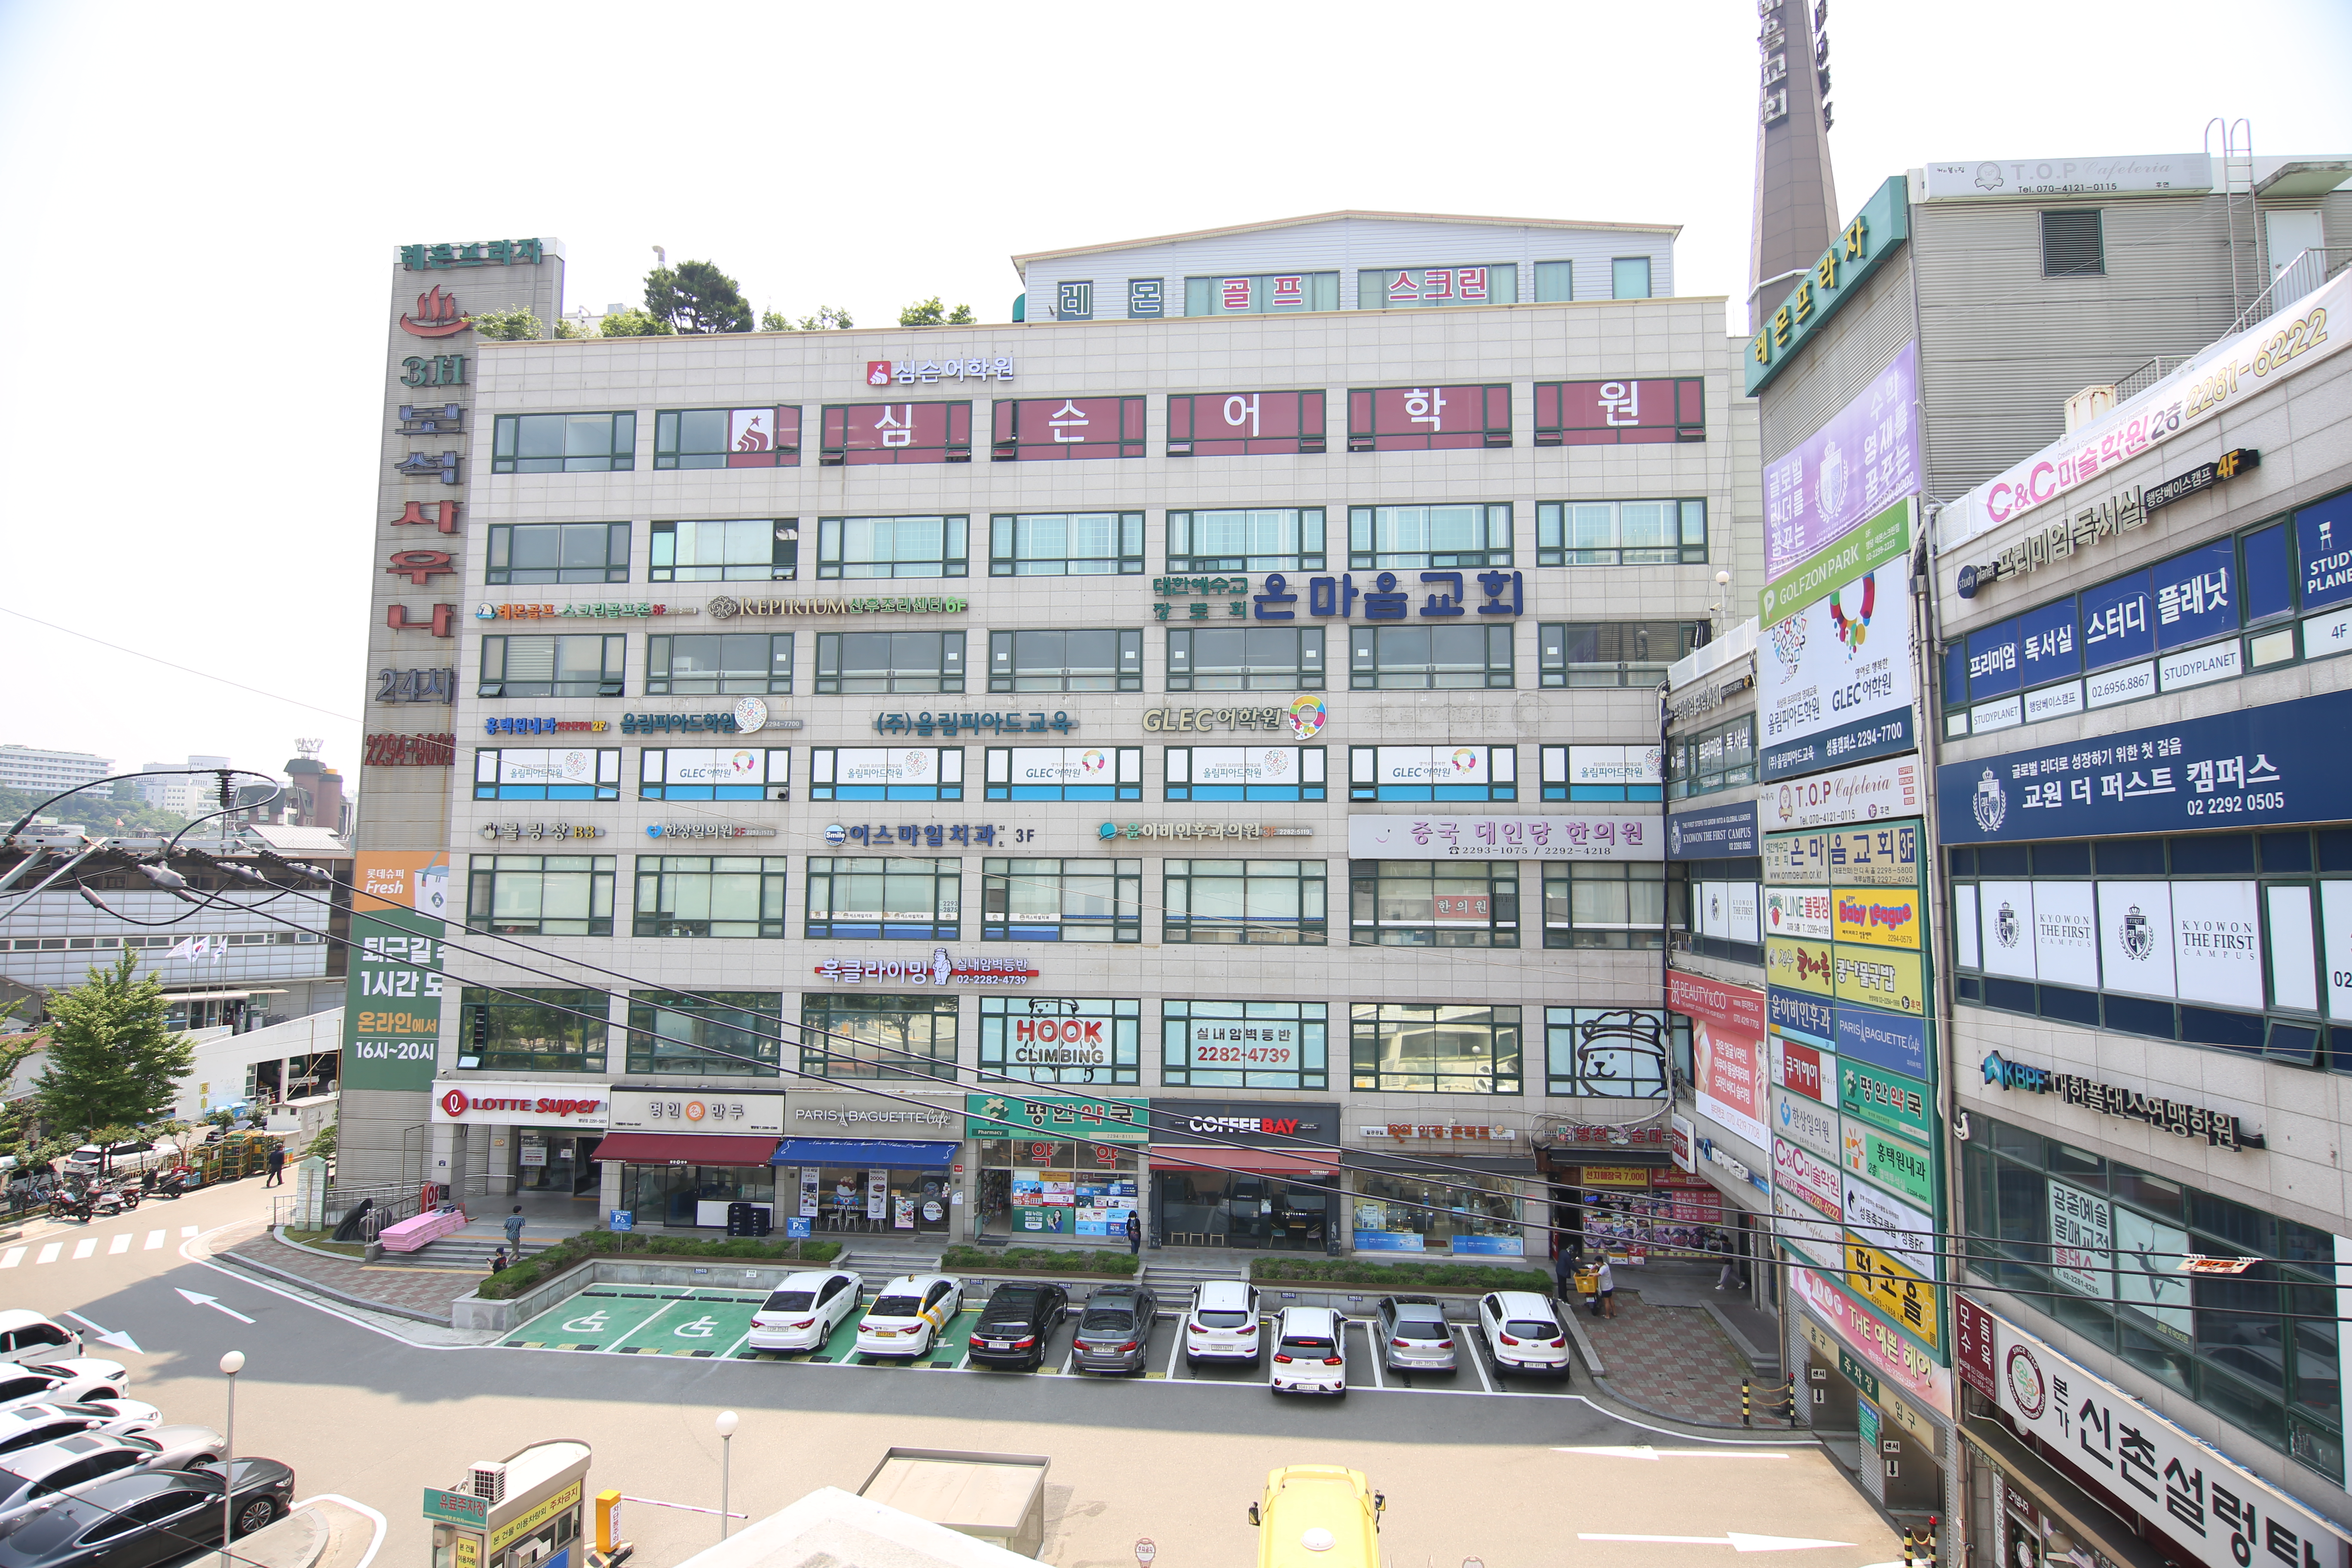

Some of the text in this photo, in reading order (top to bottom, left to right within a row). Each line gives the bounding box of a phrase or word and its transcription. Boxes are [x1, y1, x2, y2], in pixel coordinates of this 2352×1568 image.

[2037, 182, 2117, 192] 070-4121-0115
[401, 238, 543, 270] 레몬프라자
[1754, 215, 1868, 366] 레몬프라자
[895, 357, 1014, 385] 심슨어학원
[1987, 307, 2328, 523] C&C 미술학원 2층 2281-6222
[1864, 400, 1908, 466] 영재를
[1770, 456, 1803, 498] 글로벌
[1958, 451, 2240, 590] study planet 프리미엄 독서실 행당베이스캠프 4F
[1154, 576, 1248, 596] 대한예수교
[1779, 542, 1860, 605] GOLFZON PARK
[739, 596, 967, 616] REPIRIUM 산후조리센터 6F
[1253, 570, 1523, 620] 온마음교회
[497, 603, 556, 619] 레몬골프
[561, 603, 651, 619] 스크린골프존
[1969, 567, 2228, 678] 프리미엄 독서실 스터디 플래닛
[2331, 624, 2347, 639] 4F
[1855, 657, 1888, 680] 영어로 행복한
[376, 668, 452, 704] 24시
[1832, 672, 1892, 712] GLEC 어학원
[1973, 652, 2236, 726] STUDYPLANET 행당베이스캠프 02.6956.8867 STUDYPLANET
[1787, 691, 1801, 707] 프리미엄
[485, 717, 606, 735] 홍택원내과 2F
[621, 713, 735, 734] 올림피아드학원
[877, 711, 1072, 736] (주)올림피아드교육
[1143, 707, 1282, 732] GLEC 어학원
[1768, 696, 1820, 736] 올림피아드학원
[365, 733, 455, 766] 2294-9001
[1727, 727, 1748, 752] 독서실
[1826, 721, 1902, 757] 성동캠퍼스 2294-7700
[1768, 745, 1814, 770] (주)올림피아드교육
[2012, 737, 2182, 778] 글로벌 리더로 성장하기 위한 첫 걸음
[680, 768, 731, 778] GLEC 어학원
[847, 768, 902, 778] 올림피아드학원
[1026, 767, 1081, 778] GLEC 어학원
[1203, 767, 1262, 778] 올림피아드학원
[1393, 767, 1450, 777] GLEC 어학원
[1580, 767, 1642, 778] 올림피아드학원
[2022, 754, 2280, 808] 교원 더 퍼스트 캠퍼스
[1809, 805, 1890, 824] 070-4121-0115 후면
[2187, 792, 2284, 816] 02 2292 0505
[573, 826, 595, 839] B3
[665, 824, 733, 839] 한상일의원
[734, 827, 745, 836] 2F
[850, 824, 1034, 847] 이스마일치과 3F
[1126, 822, 1260, 841] 윤이비인후과의원
[1263, 826, 1276, 837] 3F
[1409, 821, 1643, 846] 중국 대인당 한의원
[1683, 827, 1751, 843] KYOWON THE FIRST CAMPUS
[1766, 841, 1788, 852] 대한예수교
[367, 869, 404, 879] 롯데슈퍼
[1770, 870, 1822, 880] www.onmaeum.or.kr
[1785, 895, 1829, 919] LINE 볼링장
[1839, 900, 1912, 931] Baby League
[2040, 913, 2090, 924] KYOWON
[1888, 934, 1912, 943] 2294-0579
[2040, 924, 2091, 939] THE FIRST
[2182, 919, 2252, 933] KYOWON
[362, 937, 432, 963] 퇴근길
[2182, 932, 2254, 950] THE FIRST
[820, 958, 928, 983] 훅클라이밍
[957, 958, 1028, 972] 실내암벽등반
[1836, 958, 1895, 993] 콩나물국밥
[361, 971, 419, 997] 1시간
[957, 975, 1028, 984] 02-2282-4739
[1771, 994, 1831, 1034] 윤이비인후과
[1017, 1020, 1102, 1043] HOOK
[1840, 1020, 1920, 1055] PARIS BAGUETTE Café
[1015, 1047, 1104, 1063] CLIMBING
[1198, 1047, 1290, 1063] 2282-4739
[472, 1098, 600, 1117] LOTTE Super
[1859, 1075, 1923, 1120] 평안약국
[2004, 1062, 2242, 1152] KBPF 대한폴댄스연맹학원
[796, 1109, 951, 1129] PARIS BAGUETTE Café
[1726, 1114, 1760, 1139] 070.4219.7708
[1792, 1106, 1830, 1144] 한상일의원
[1032, 1142, 1053, 1167] 약
[1096, 1145, 1118, 1170] 약
[1877, 1142, 1925, 1182] 홍택원내과
[1586, 1171, 1645, 1181] 선지해장국 7,000
[1775, 1139, 1804, 1176] C&C
[1805, 1158, 1839, 1199] 미술학원
[1810, 1192, 1840, 1218] 2281-6222
[2052, 1185, 2108, 1229] 공중예술
[2054, 1218, 2110, 1259] 몸매교정
[1811, 1326, 1826, 1350] 출구
[1849, 1305, 1871, 1341] THE
[1874, 1324, 1899, 1365] 예쁜
[1903, 1342, 1932, 1388] 헤어
[1844, 1357, 1873, 1393] 주차장
[1895, 1401, 1916, 1430] 입구
[440, 1494, 486, 1517] 유료주차장
[493, 1485, 578, 1546] 본 건물 이용차량외 주차금지
[612, 1503, 620, 1542] 차단봉주의
[458, 1554, 476, 1565] 이용차량
[466, 1545, 475, 1554] 건물
